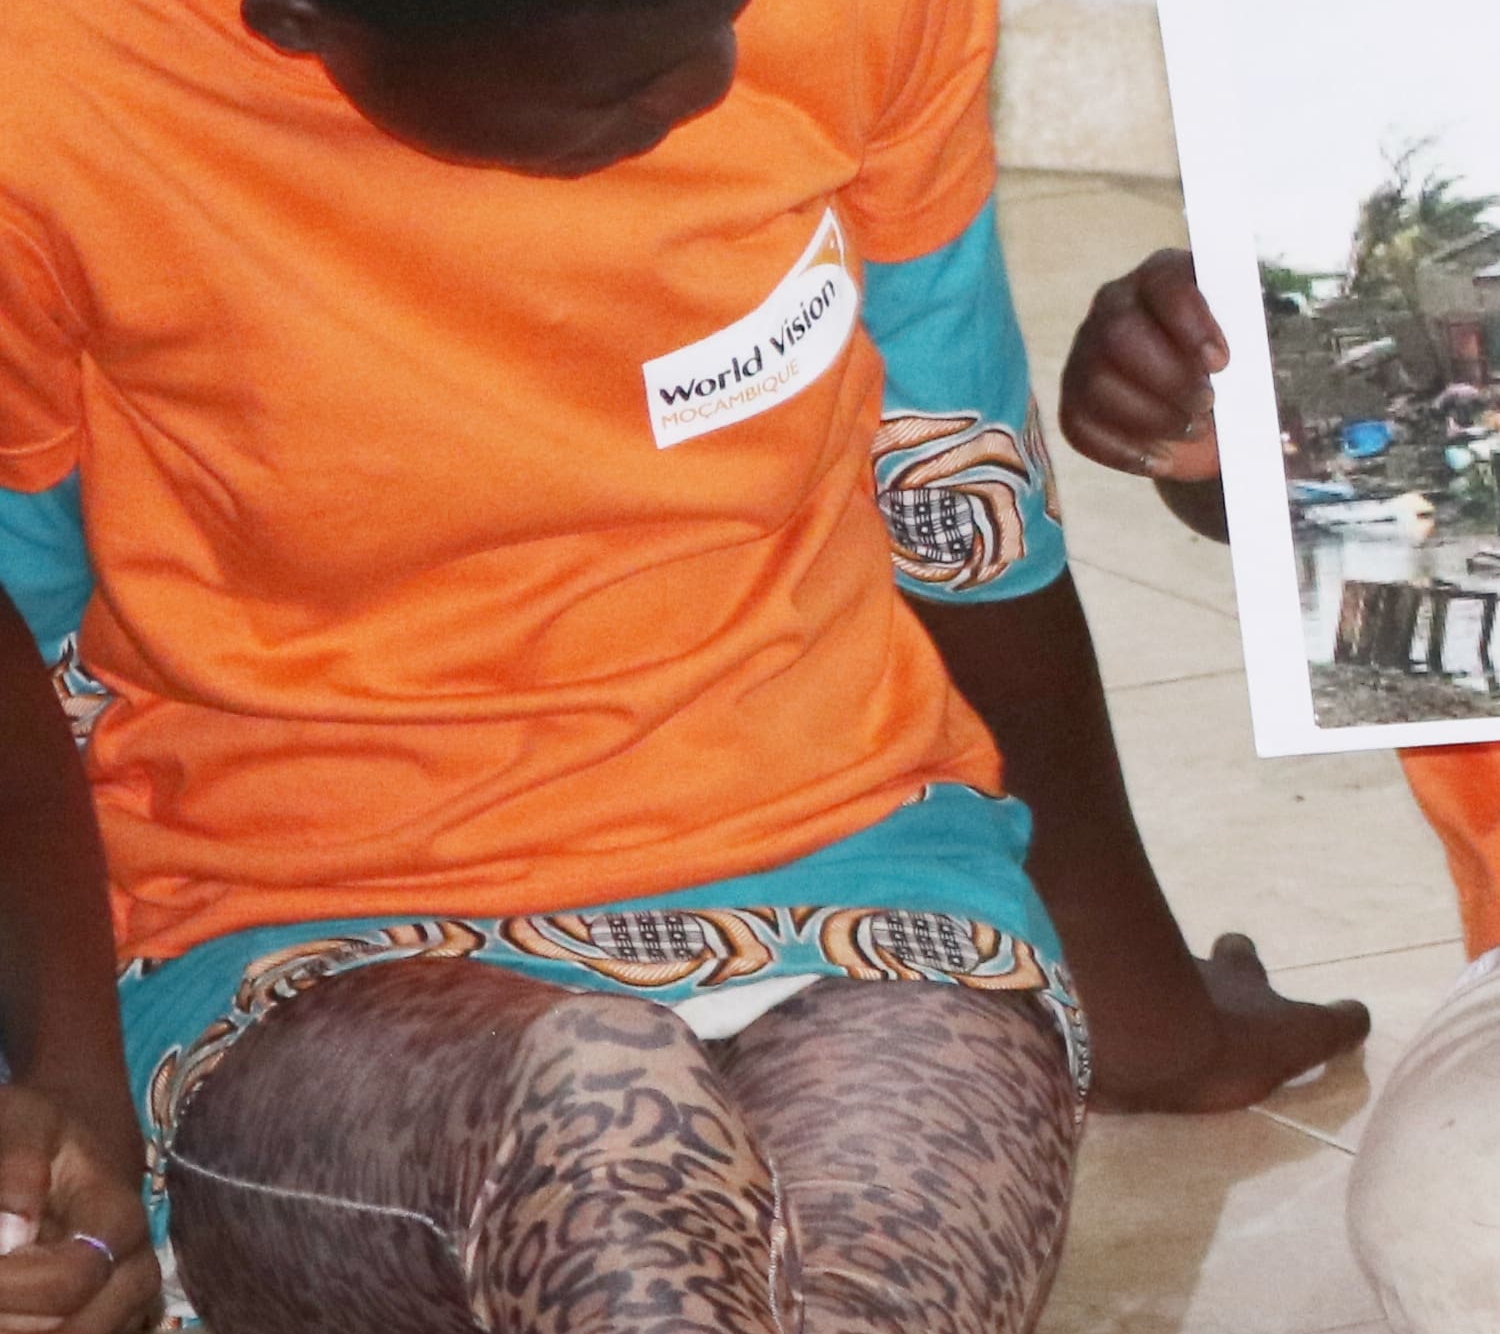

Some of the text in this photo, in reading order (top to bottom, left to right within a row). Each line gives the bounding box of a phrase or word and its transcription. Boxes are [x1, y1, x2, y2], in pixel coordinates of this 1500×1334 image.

[659, 279, 836, 405] World Vision
[660, 361, 800, 430] MOÇAMBIQUE
